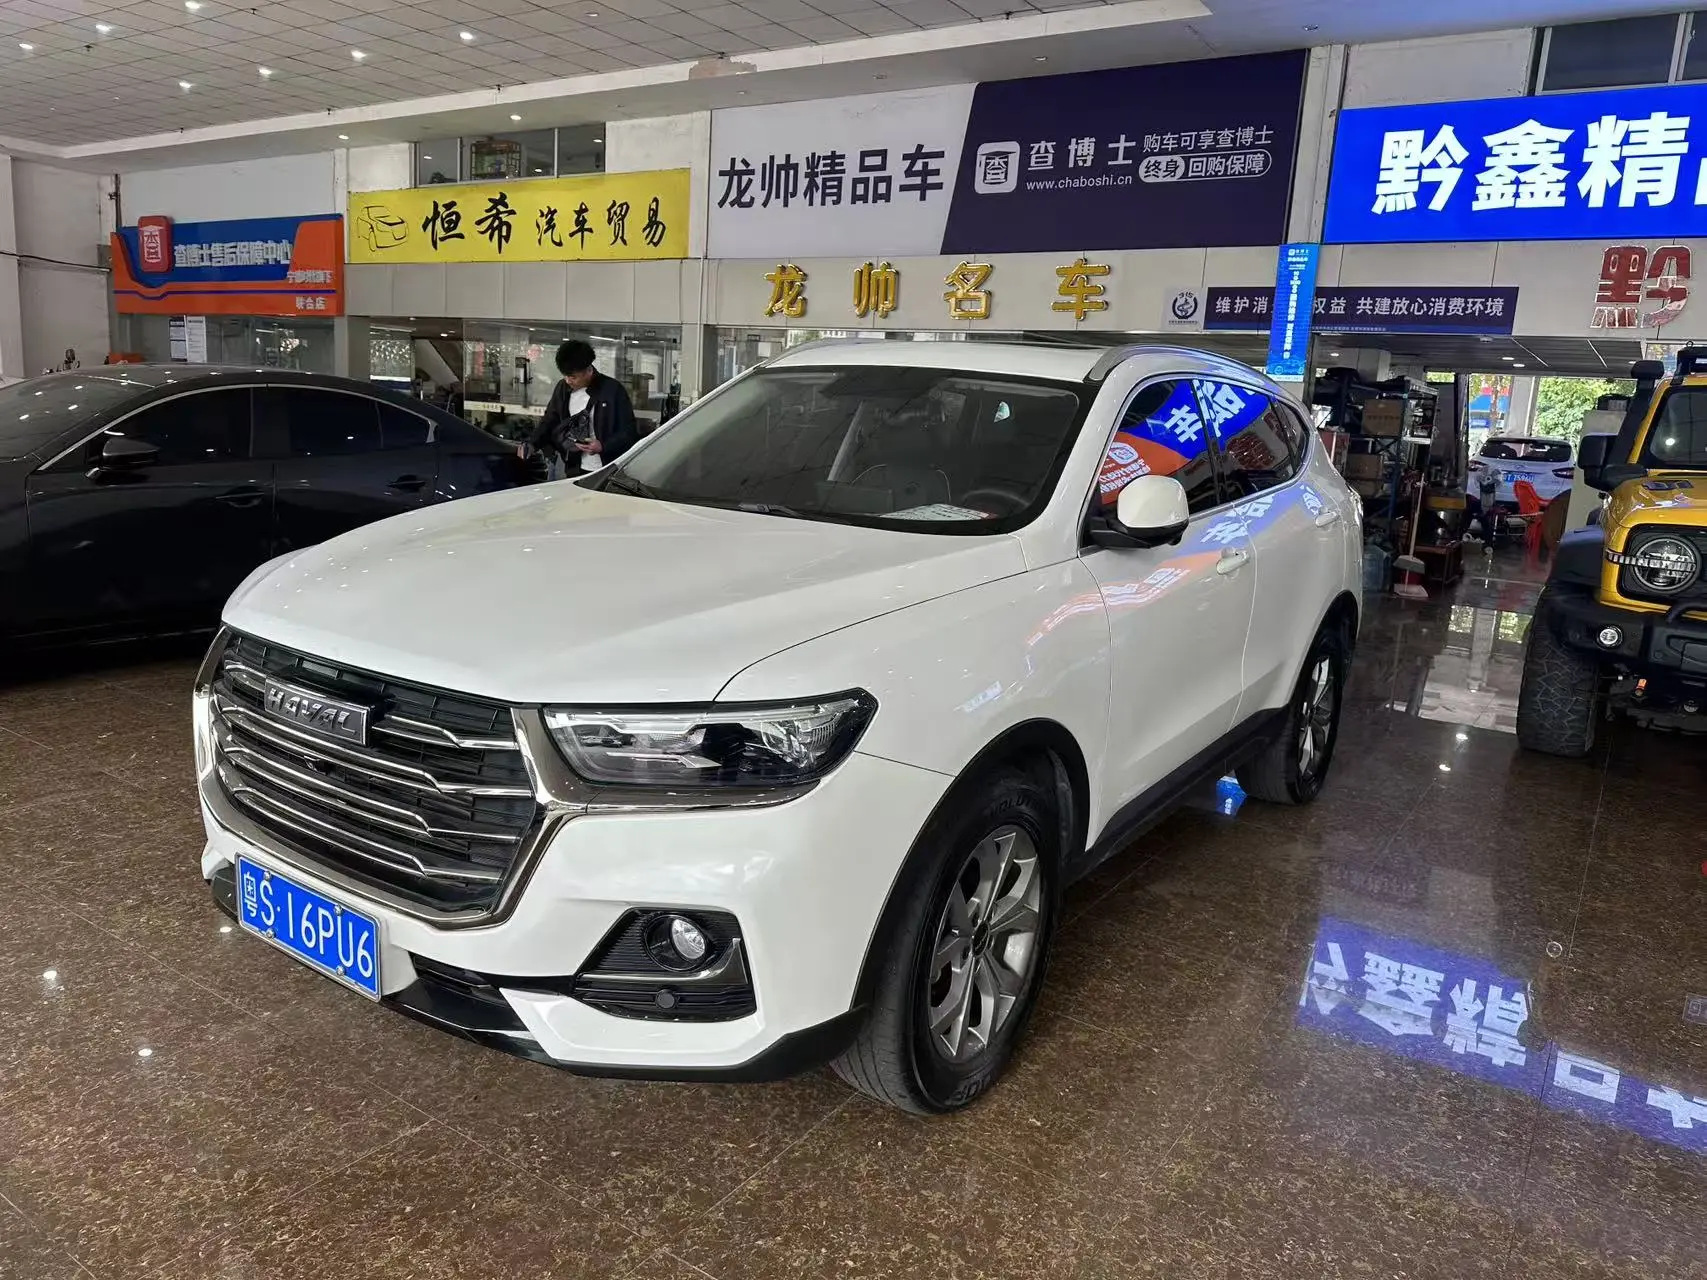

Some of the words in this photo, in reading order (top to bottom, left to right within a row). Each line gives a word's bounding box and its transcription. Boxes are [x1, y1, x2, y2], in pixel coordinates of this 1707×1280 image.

[1027, 134, 1137, 171] 查博士
[1143, 125, 1275, 153] 购车可享查博士
[717, 143, 945, 209] 龙帅精品车
[1143, 158, 1181, 179] 终身
[1188, 154, 1266, 178] 回购保障
[1371, 111, 1707, 215] 黔鑫精
[1026, 174, 1133, 191] www.chaboshi.cn
[422, 191, 518, 255] 恒希
[534, 196, 667, 251] 汽车贸易
[174, 239, 292, 268] 查博士售后保障中心
[763, 258, 1111, 323] 龙帅名车
[1215, 296, 1347, 315] 维护消权益
[1356, 296, 1505, 318] 共建放心消费环境
[267, 687, 356, 735] HAVAL
